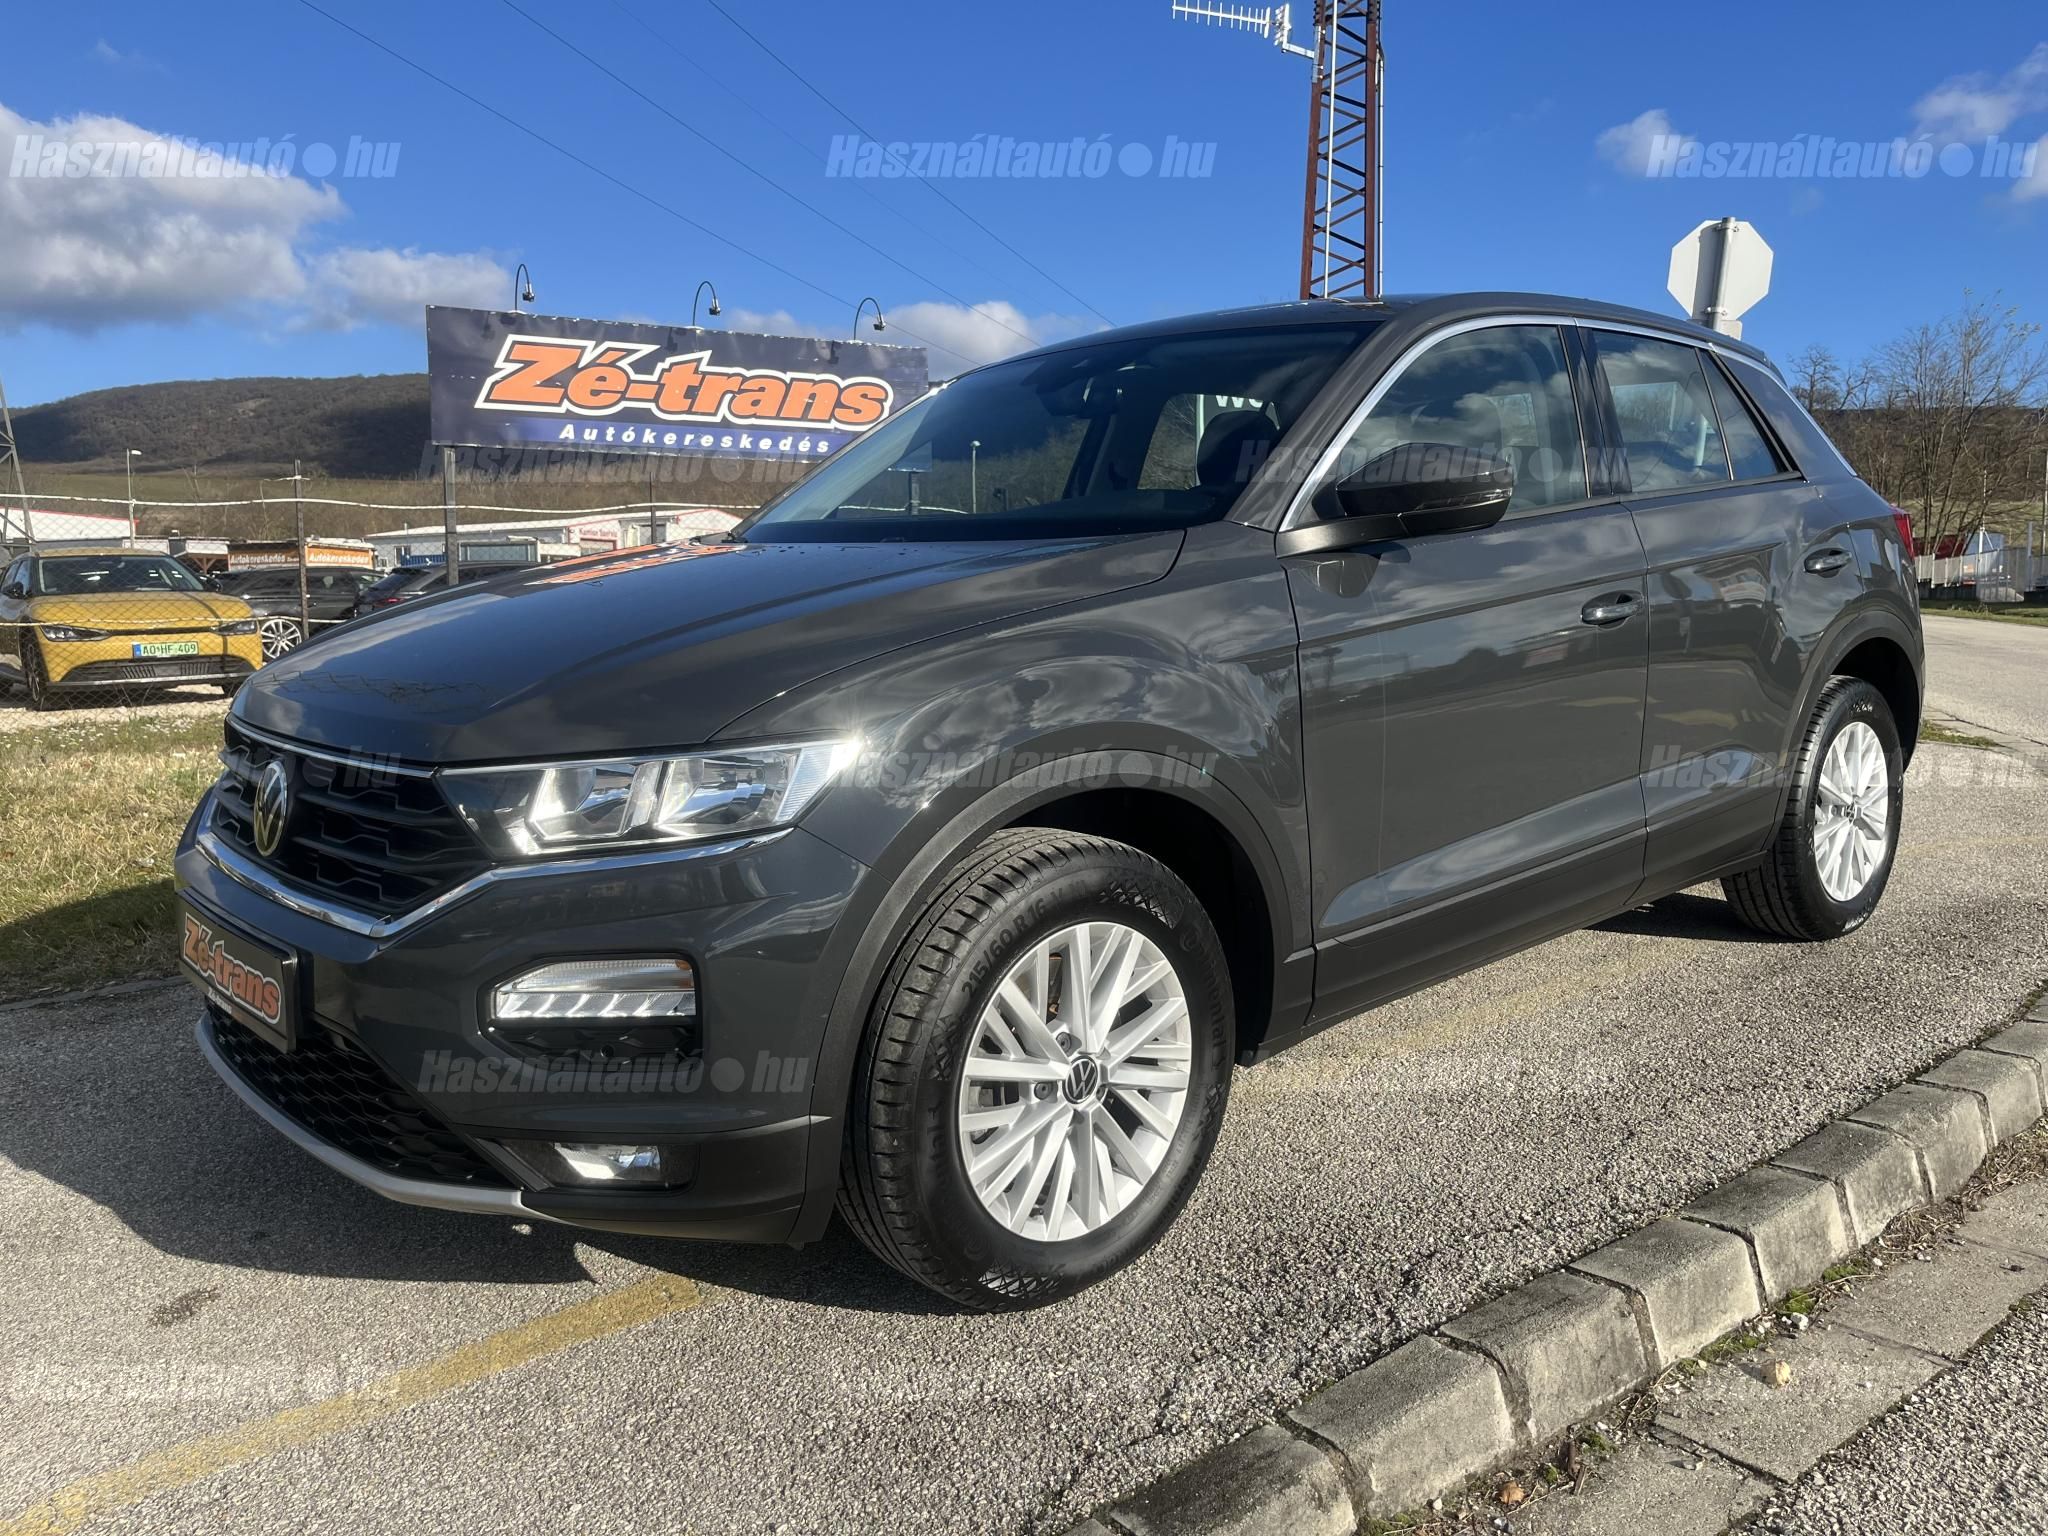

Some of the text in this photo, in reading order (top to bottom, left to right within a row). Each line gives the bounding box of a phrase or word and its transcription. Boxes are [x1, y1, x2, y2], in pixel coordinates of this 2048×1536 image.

[475, 333, 895, 432] Zé-trans
[558, 422, 831, 454] Autókereskedés
[183, 911, 282, 1025] Zé-trans
